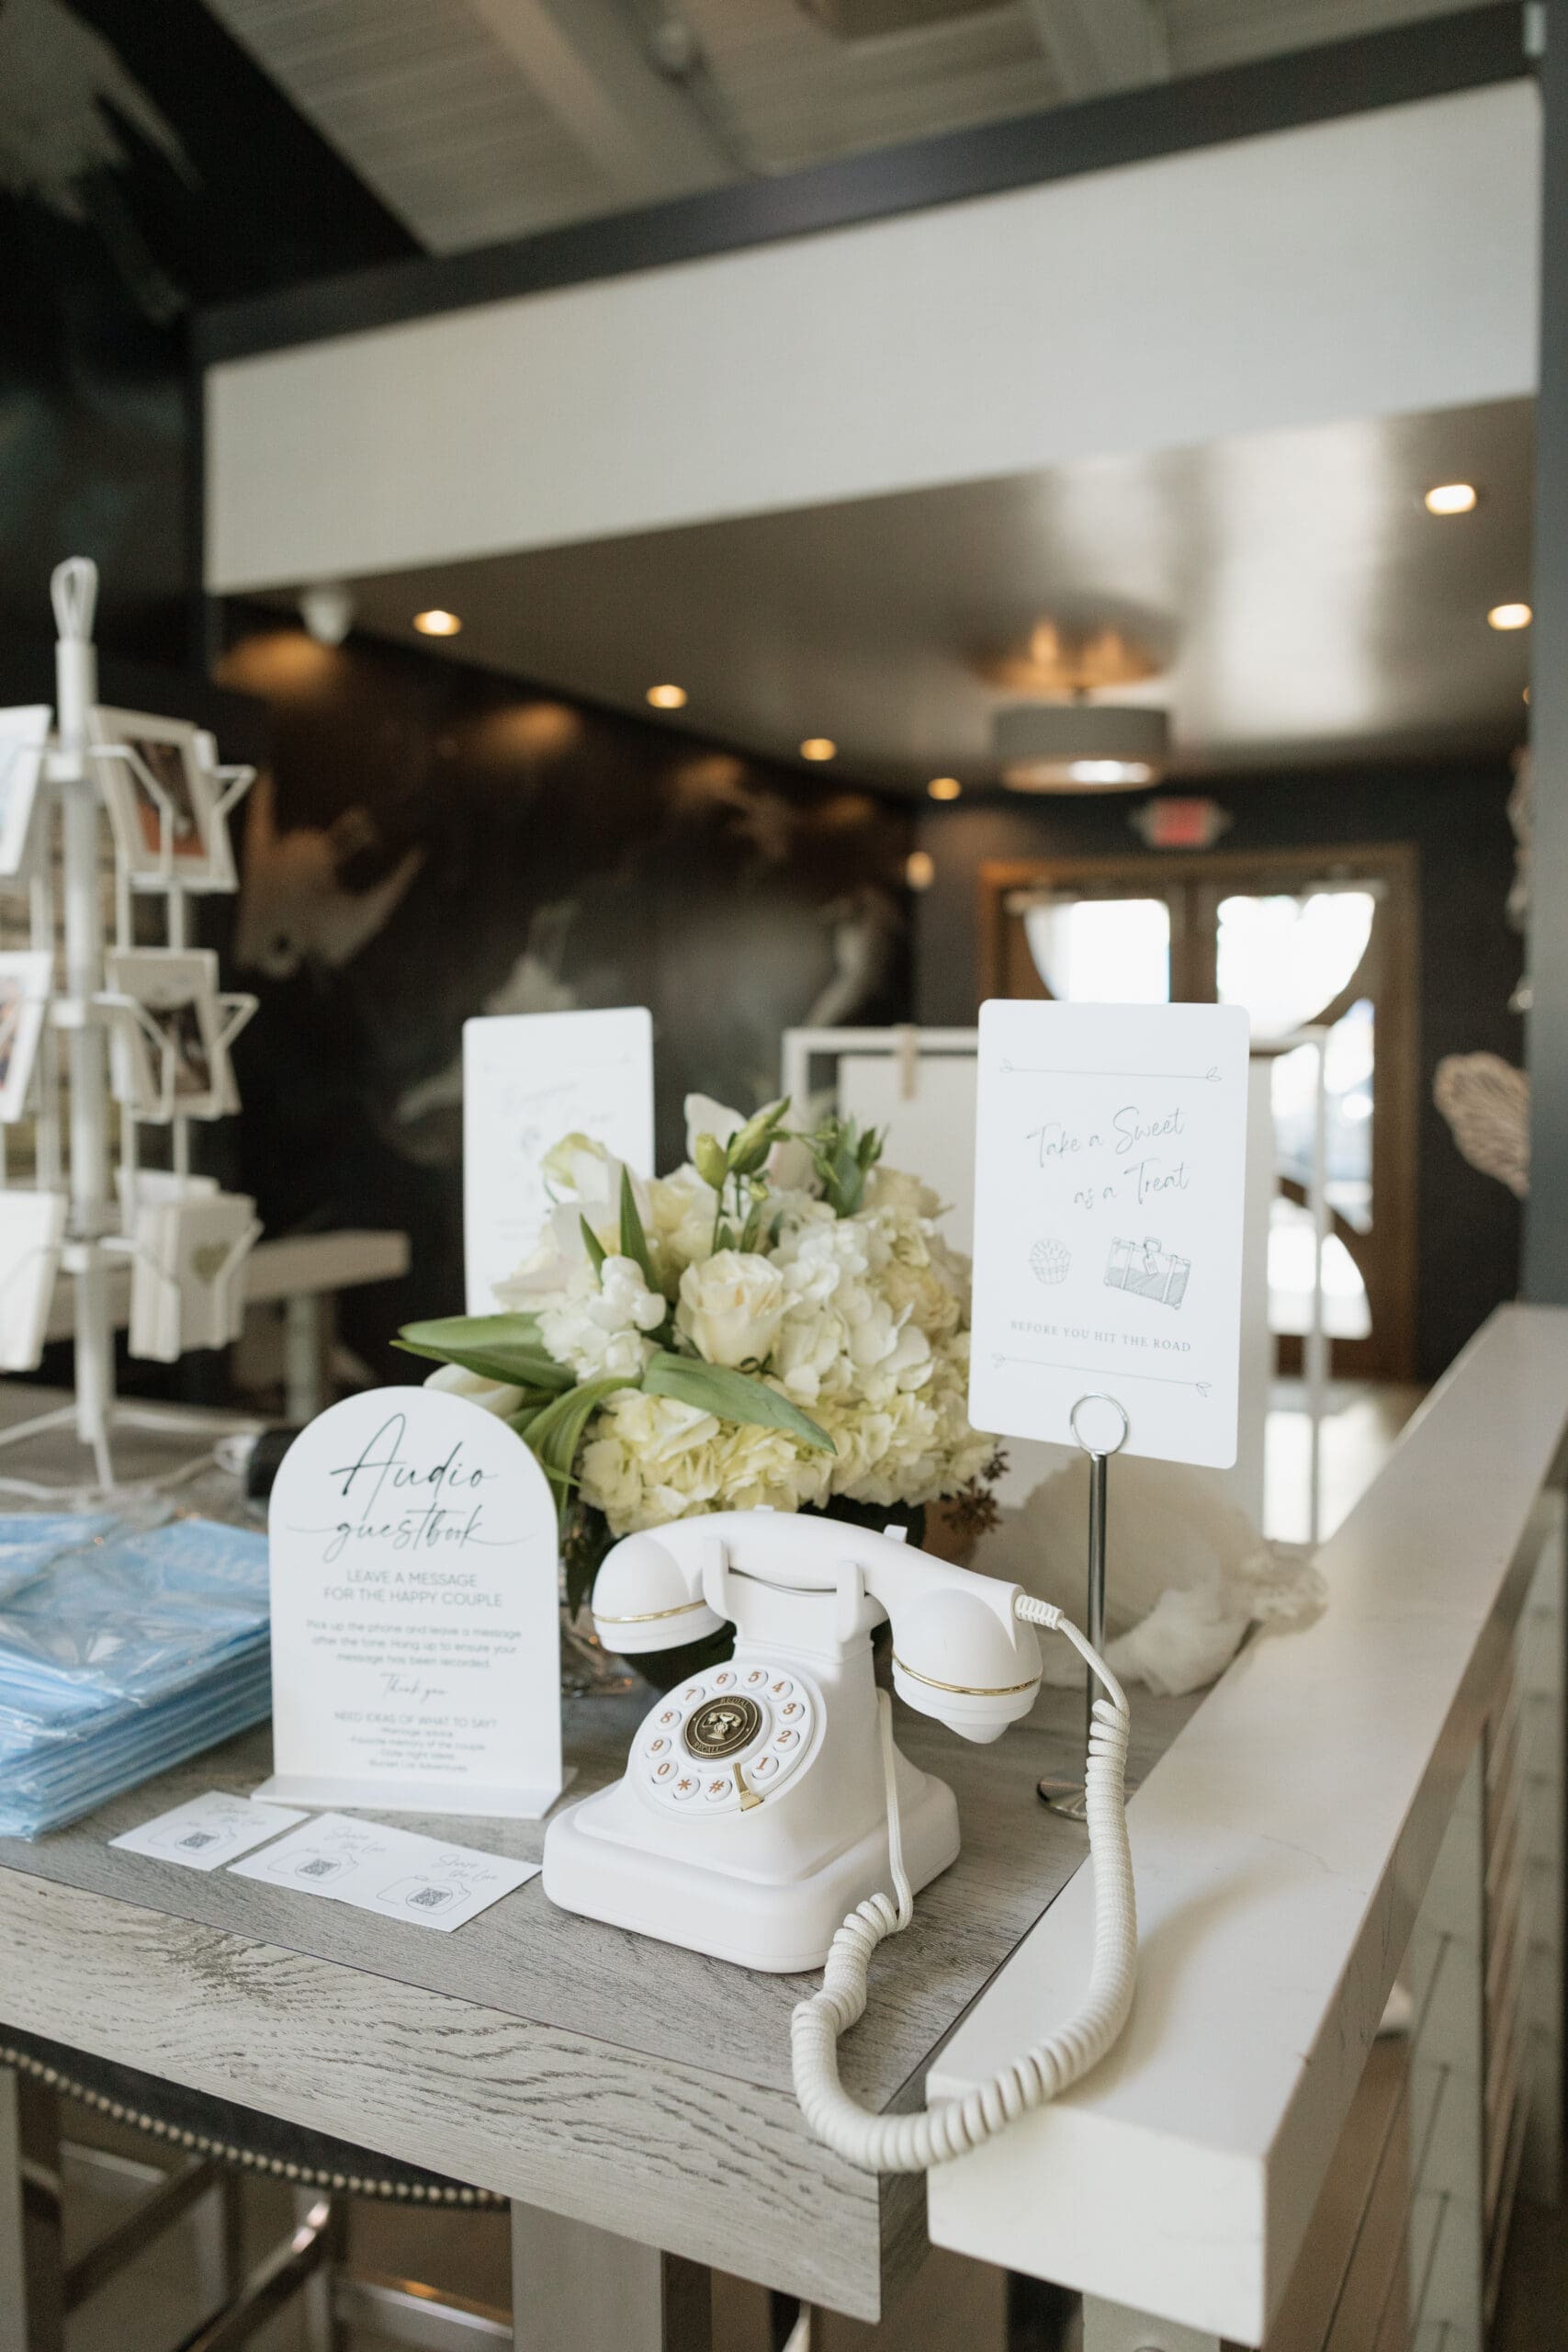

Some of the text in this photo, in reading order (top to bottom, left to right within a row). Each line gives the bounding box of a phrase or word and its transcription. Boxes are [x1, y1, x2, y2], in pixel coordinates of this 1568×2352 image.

[1026, 1105, 1189, 1168] Take a Sweet
[1074, 1158, 1190, 1209] as a Treat
[1010, 1320, 1191, 1352] BEFORE YOU HIT THE ROAD
[329, 1413, 500, 1521] Audio
[286, 1502, 537, 1563] guestbook
[346, 1568, 478, 1588] LEAVE A MESSAGE
[323, 1587, 503, 1608] FOR THE HAPPY COUPLE
[306, 1619, 523, 1641] Pick up the phone and leave a message
[311, 1635, 337, 1645] after
[340, 1636, 358, 1647] the
[389, 1640, 420, 1652] Hang
[423, 1643, 437, 1653] up
[439, 1641, 452, 1652] to
[454, 1643, 491, 1653] ensure
[492, 1645, 518, 1657] your
[336, 1653, 384, 1666] message
[387, 1655, 408, 1665] has
[409, 1655, 438, 1666] been
[716, 1672, 728, 1685] 6
[748, 1671, 761, 1683] 5
[771, 1680, 785, 1693] 4
[685, 1689, 696, 1701] 7
[720, 1697, 750, 1709] REDIAL
[783, 1702, 796, 1715] 3
[333, 1711, 498, 1729] NEED IDEAS OF WHAT TO SAY?
[660, 1712, 673, 1724] 8
[777, 1730, 792, 1744] 2
[651, 1739, 664, 1751] 9
[694, 1741, 721, 1753] RECALL
[657, 1762, 671, 1776] 0
[755, 1757, 770, 1770] 1
[708, 1779, 725, 1793] #
